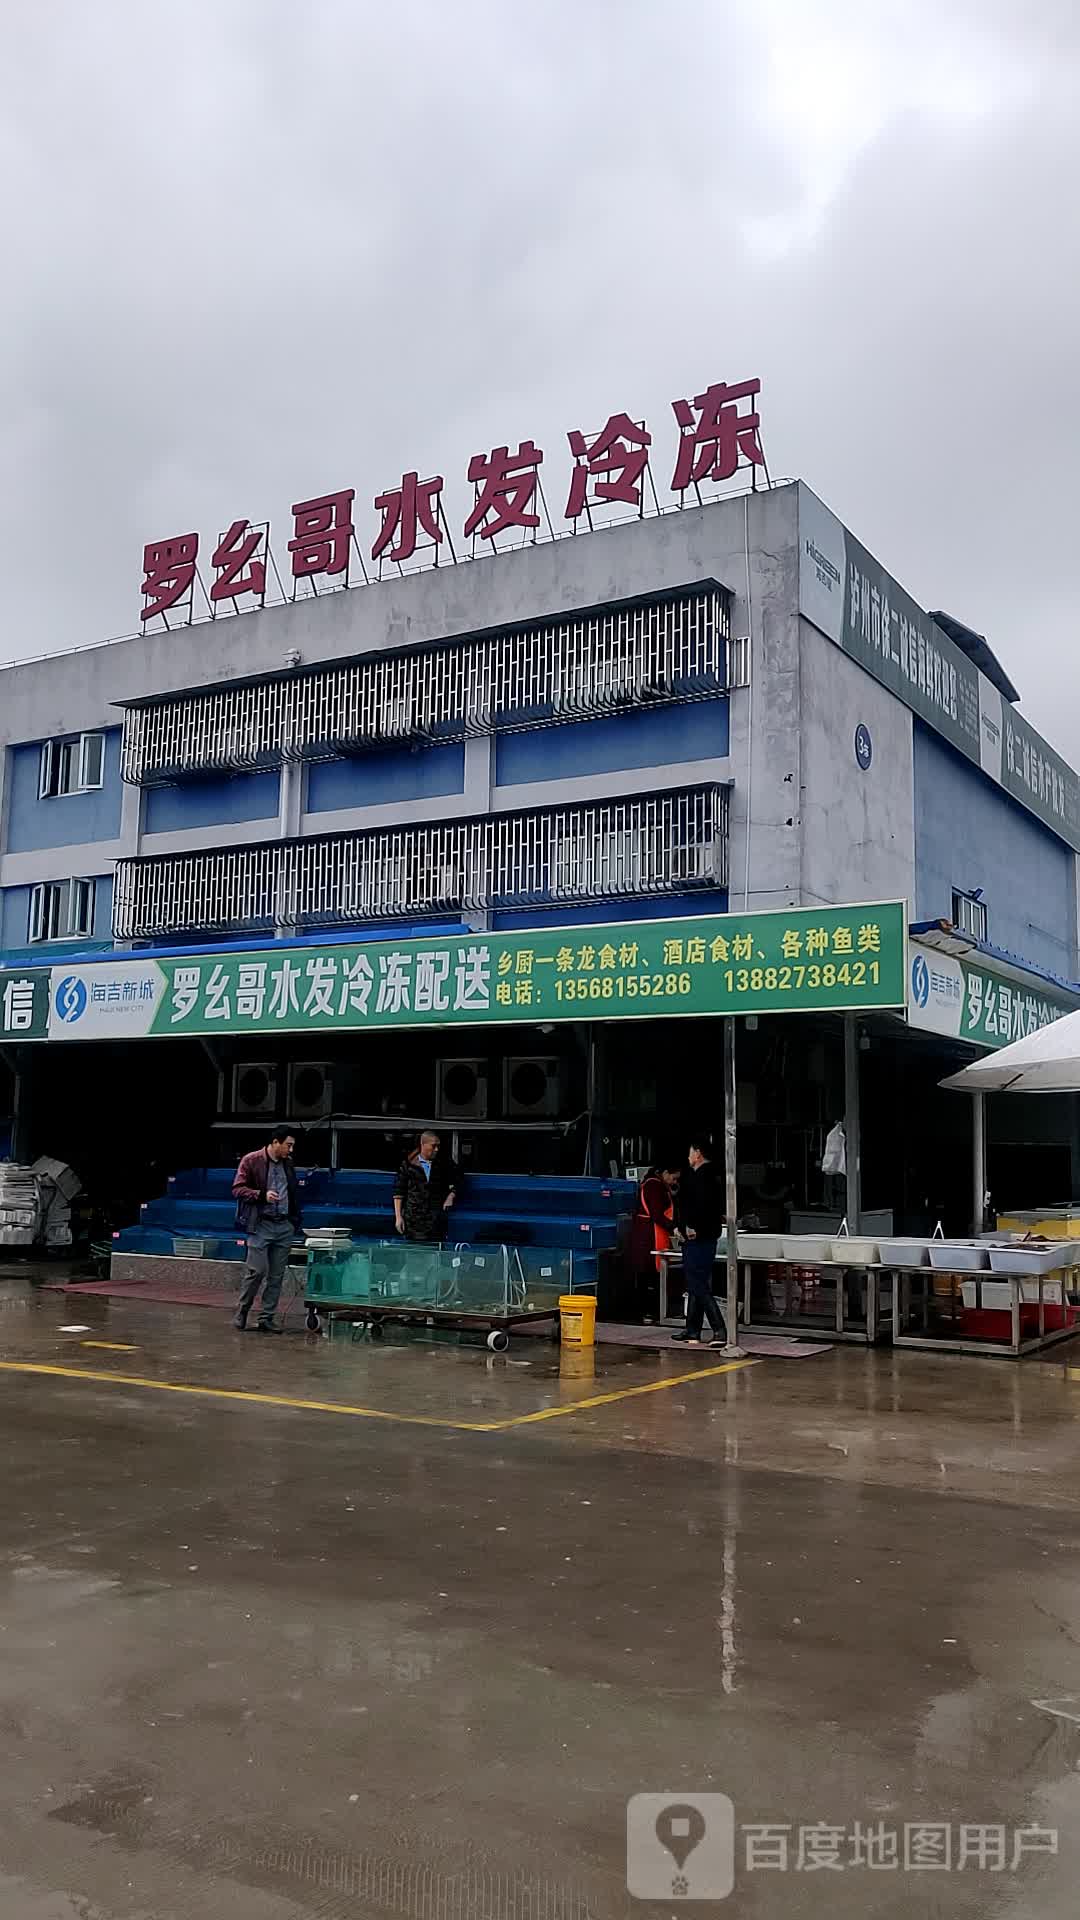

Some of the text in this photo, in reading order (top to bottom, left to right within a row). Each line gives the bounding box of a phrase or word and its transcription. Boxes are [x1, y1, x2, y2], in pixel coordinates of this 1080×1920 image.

[140, 377, 765, 622] 罗幺哥水发冷冻
[90, 978, 155, 1003] 海吉新城
[171, 945, 491, 1024] 罗幺哥水发冷冻配送
[724, 961, 880, 993] 13882738421
